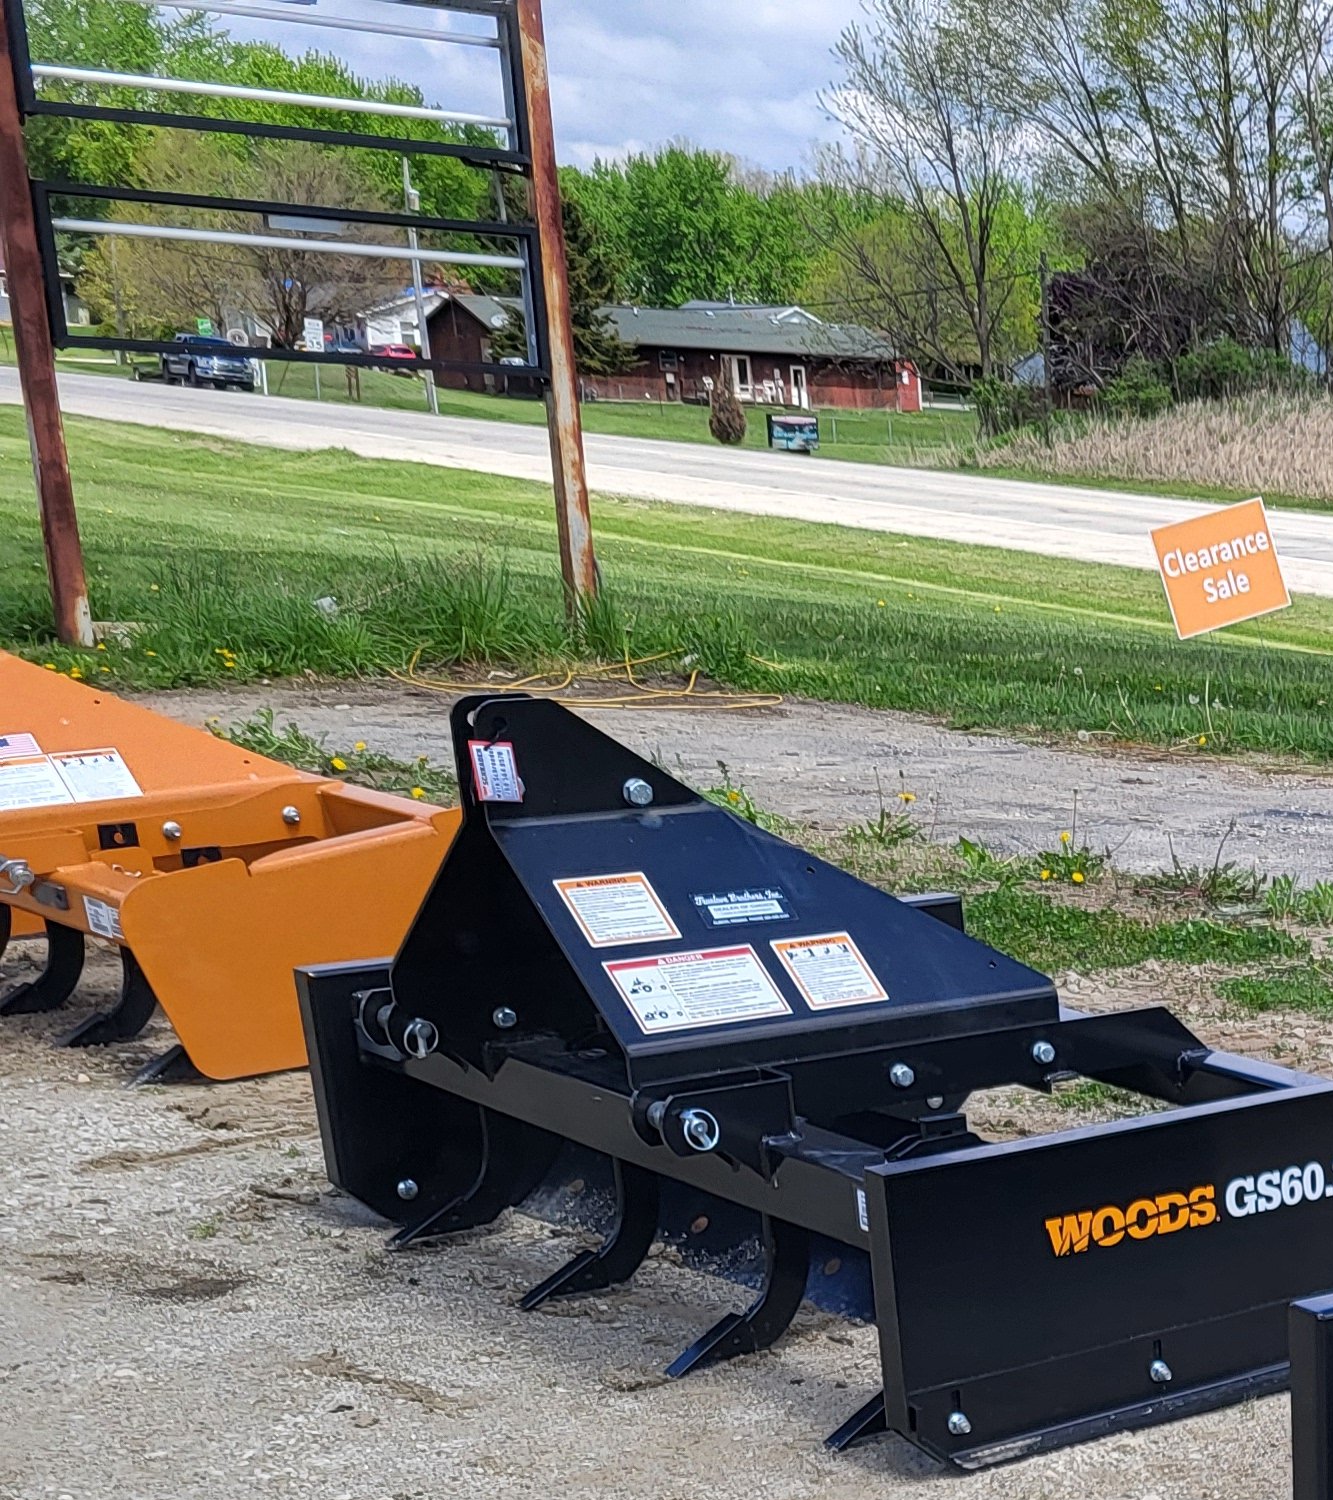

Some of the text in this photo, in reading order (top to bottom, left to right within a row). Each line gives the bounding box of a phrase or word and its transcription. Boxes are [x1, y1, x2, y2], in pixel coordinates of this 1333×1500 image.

[1163, 530, 1270, 578] Clearance
[1203, 568, 1250, 603] Sale
[585, 877, 628, 888] WARNING
[665, 953, 704, 965] DANGER
[1045, 1183, 1217, 1258] WOODS
